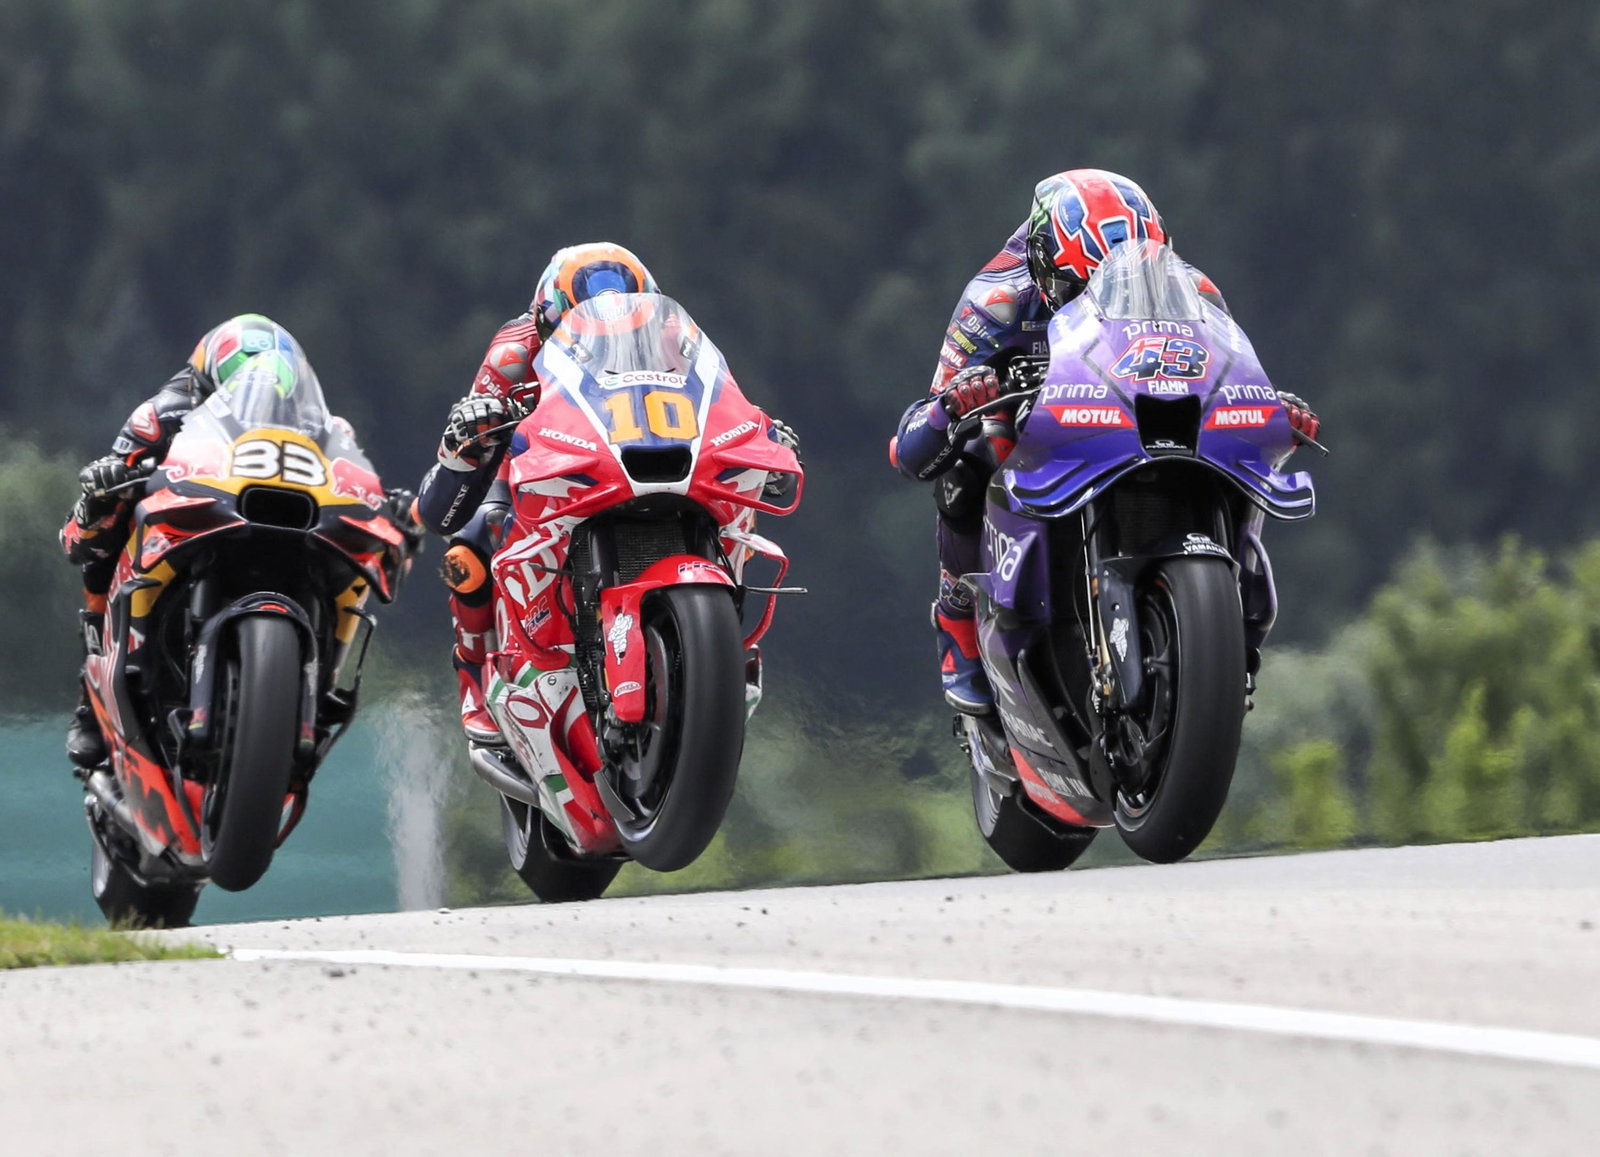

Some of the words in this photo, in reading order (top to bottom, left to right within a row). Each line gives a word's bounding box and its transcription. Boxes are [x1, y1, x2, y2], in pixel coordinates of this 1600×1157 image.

[1122, 320, 1194, 340] prima
[940, 344, 964, 367] OTUL
[1110, 336, 1213, 383] 43
[622, 373, 683, 385] Castrol
[1148, 381, 1188, 394] FIAMM
[1042, 384, 1108, 404] prima
[1220, 384, 1277, 405] prima
[604, 389, 698, 443] 10
[1061, 408, 1122, 424] MOTUL
[1215, 409, 1265, 425] MOTUL
[537, 427, 598, 452] HONDA
[710, 420, 760, 447] HONDA
[231, 439, 328, 487] 33
